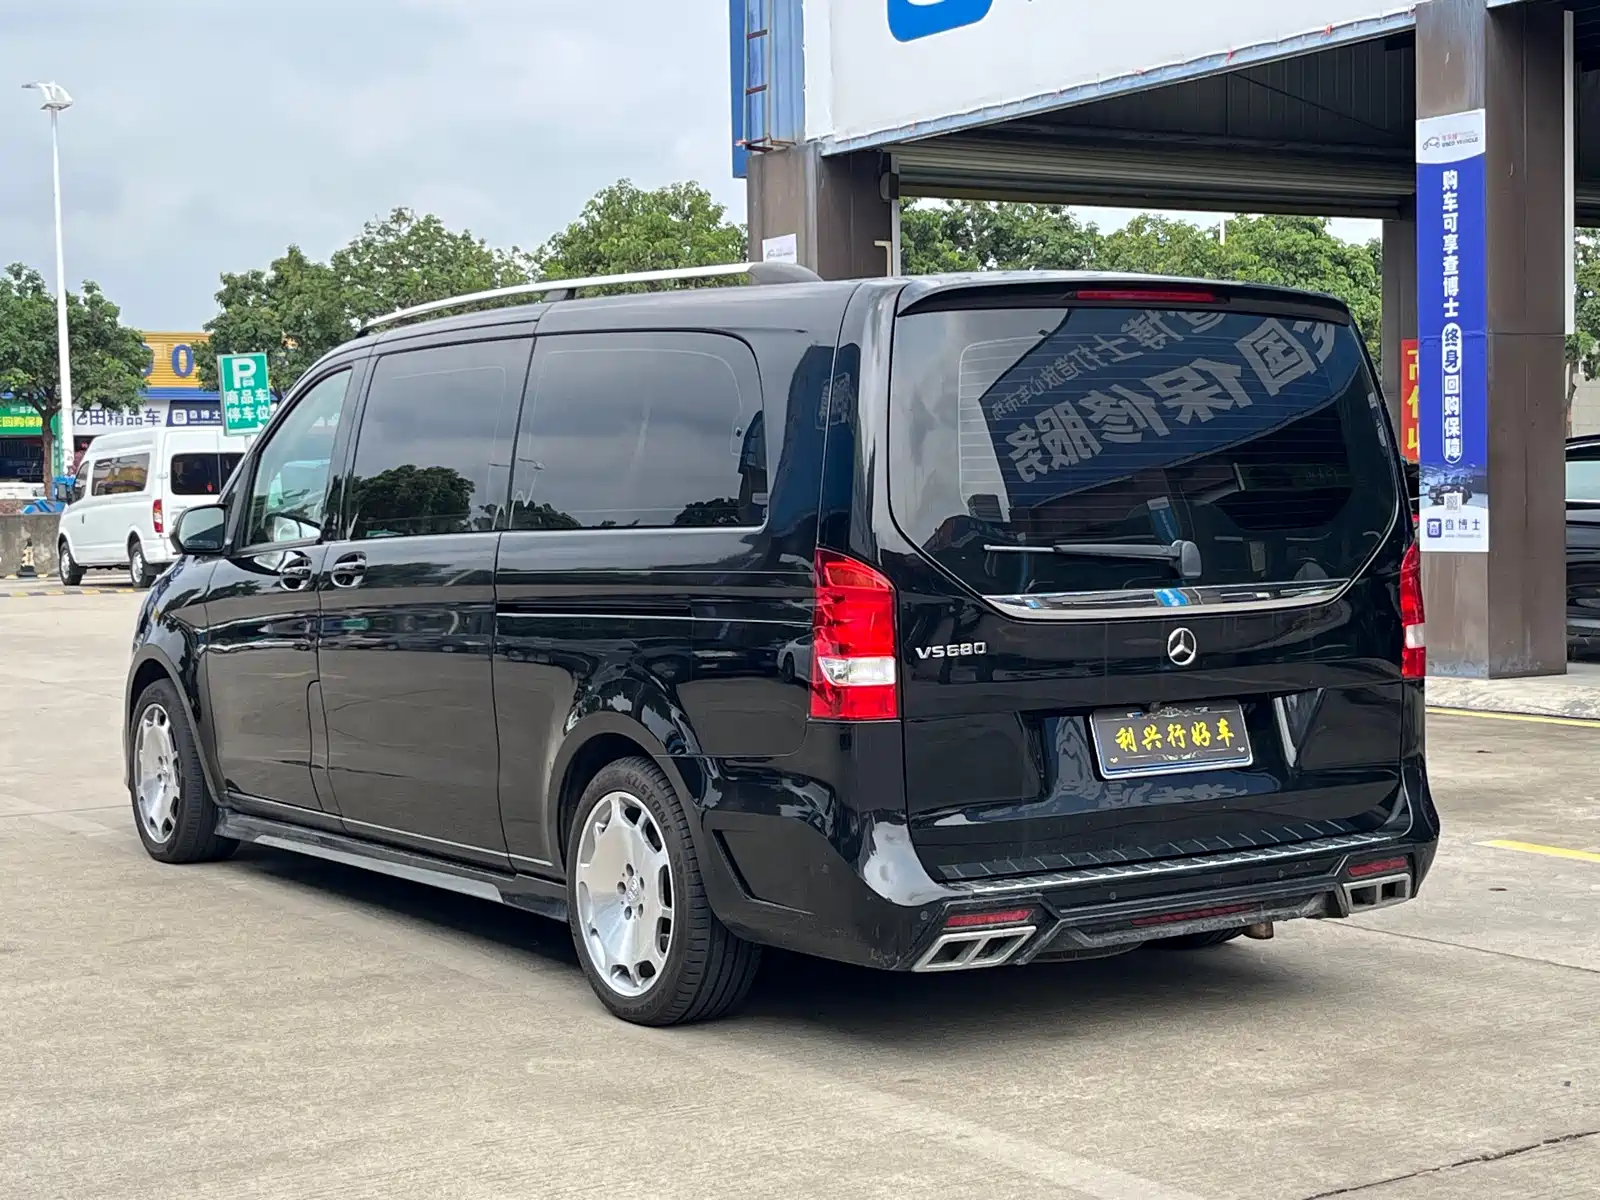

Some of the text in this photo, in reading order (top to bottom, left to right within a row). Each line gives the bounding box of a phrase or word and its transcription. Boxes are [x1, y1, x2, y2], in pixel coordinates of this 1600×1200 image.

[1442, 169, 1460, 458] 购车可享查博士 终身回购保障
[231, 358, 256, 388] P
[226, 388, 269, 406] 商品车
[0, 416, 43, 428] 回购保
[227, 405, 271, 423] 停车位
[1445, 518, 1481, 531] 查博士
[915, 642, 987, 659] VS680
[1115, 717, 1235, 752] 利兴行好车
